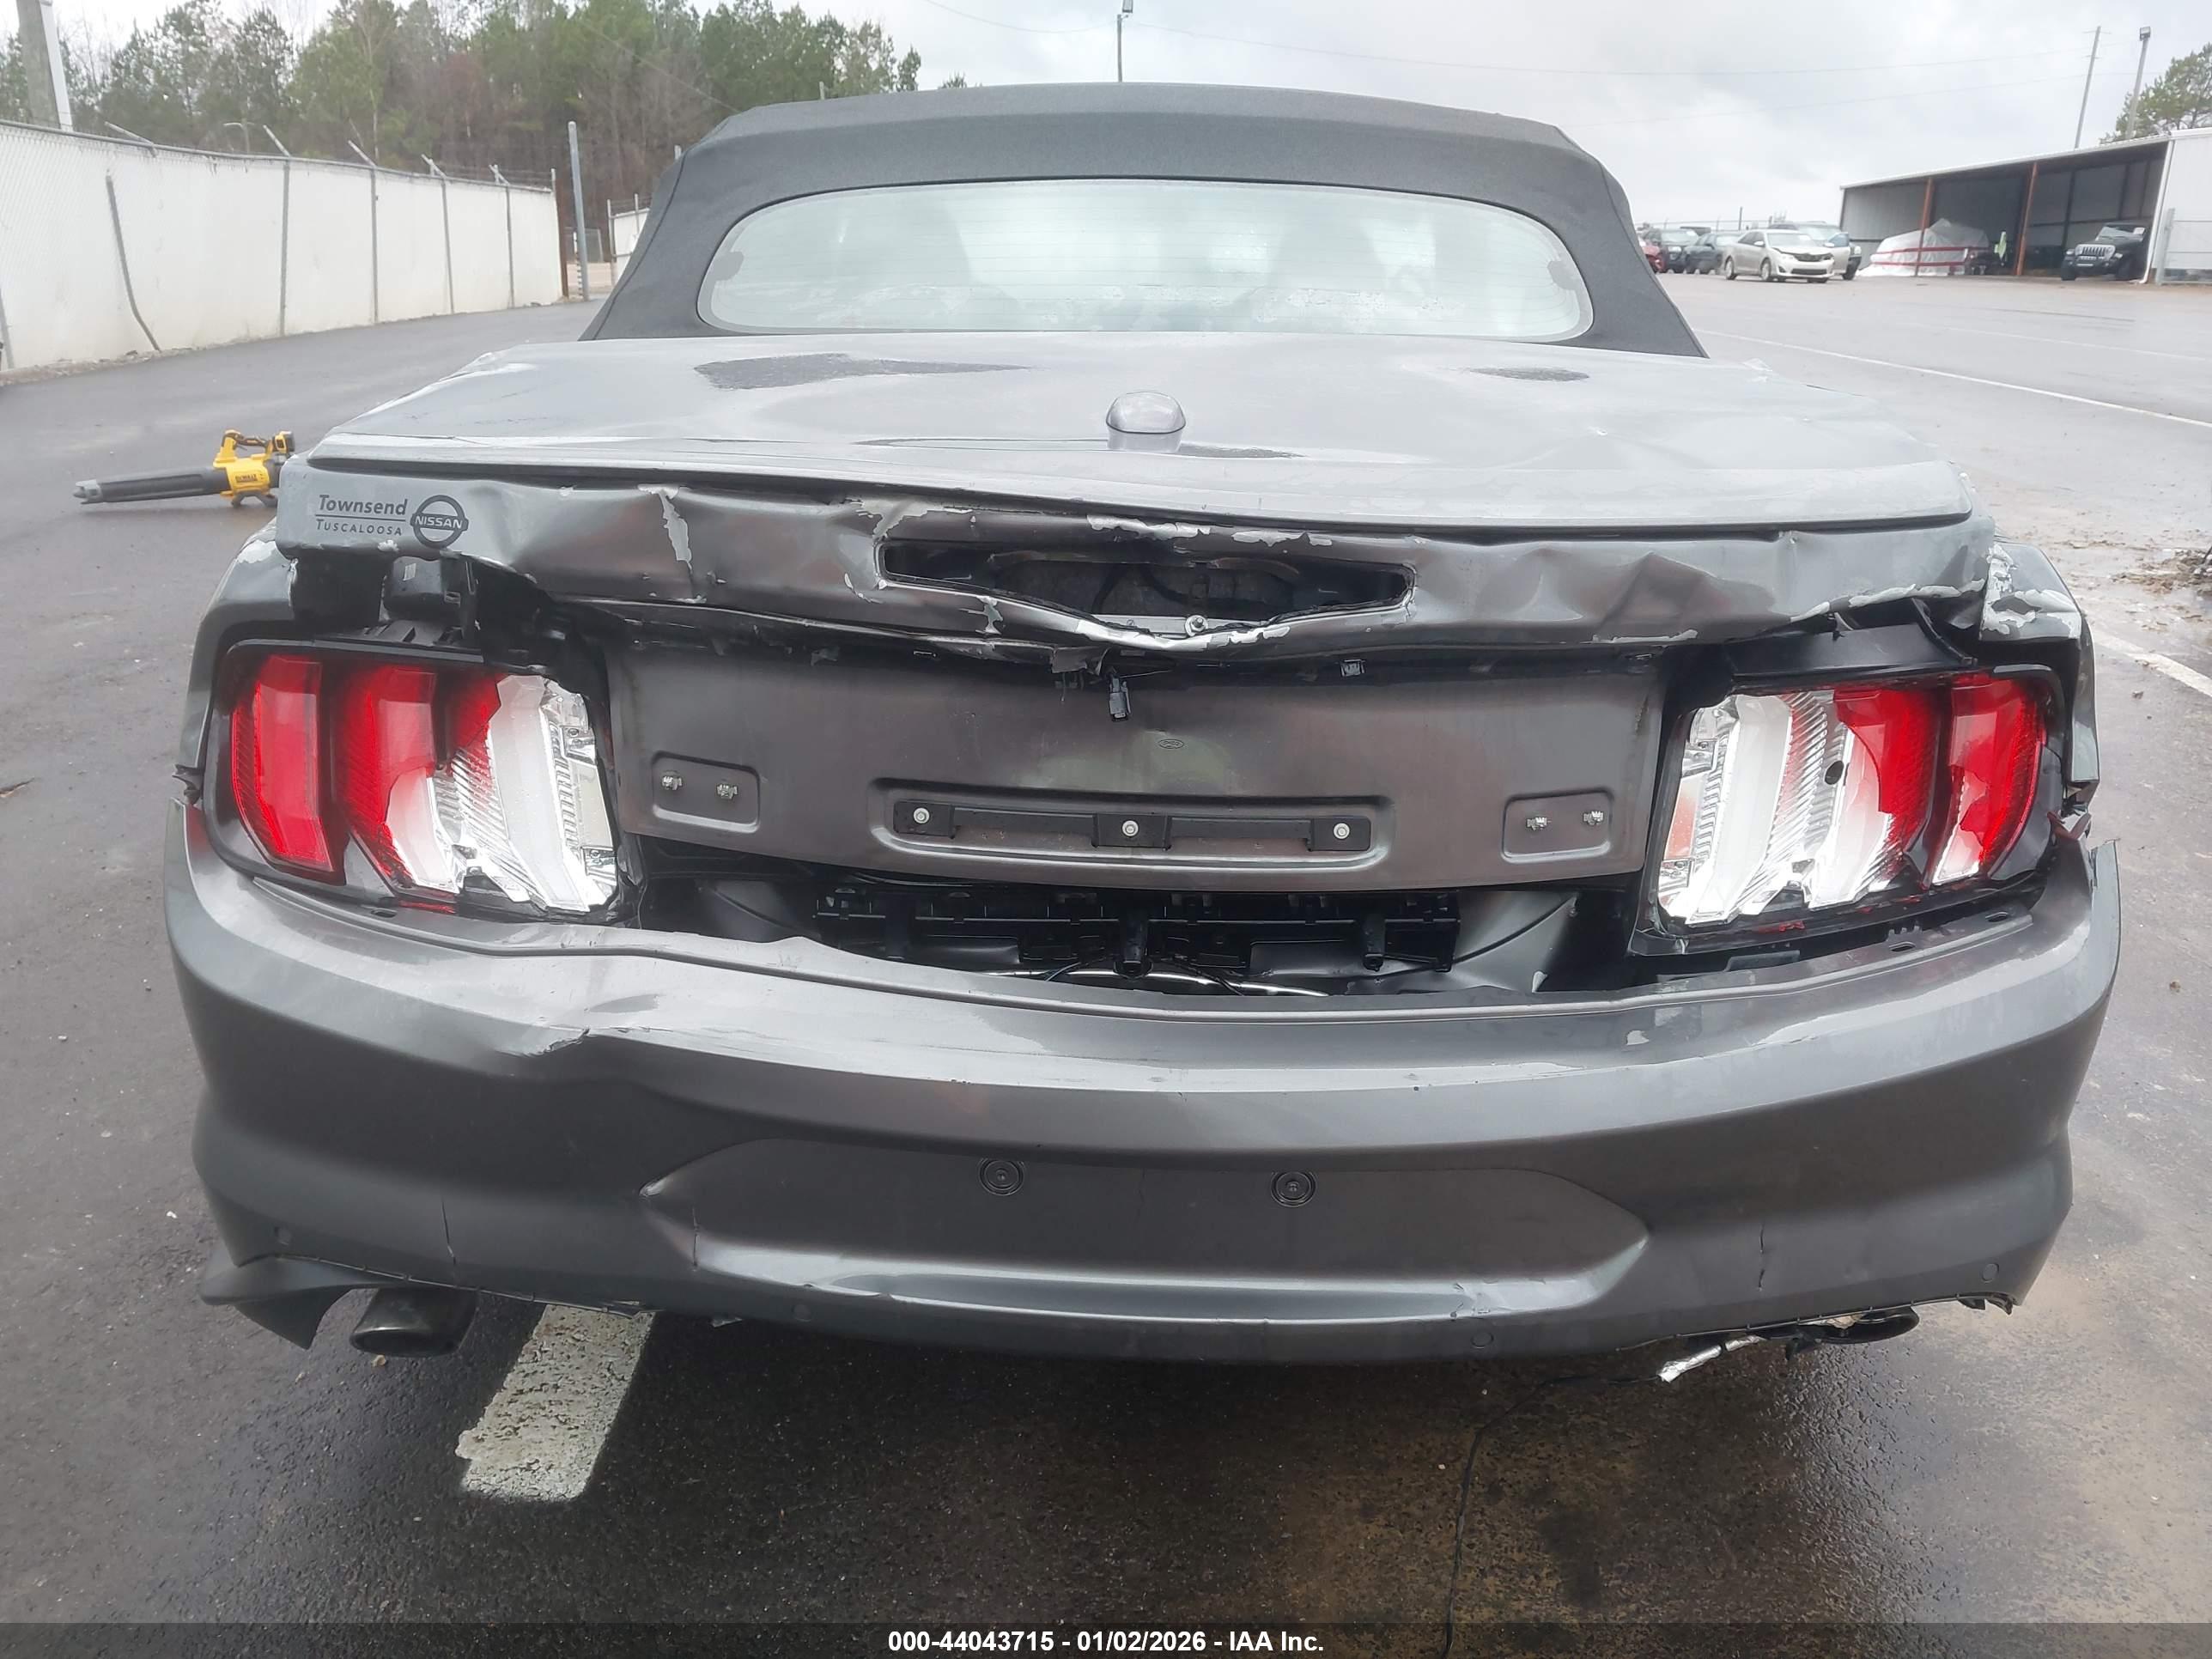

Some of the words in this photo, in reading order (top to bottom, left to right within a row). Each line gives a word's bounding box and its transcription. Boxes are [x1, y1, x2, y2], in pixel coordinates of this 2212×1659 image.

[319, 494, 408, 515] Townsend
[316, 518, 402, 536] TUSCALOOSA
[415, 515, 463, 529] NISSAN
